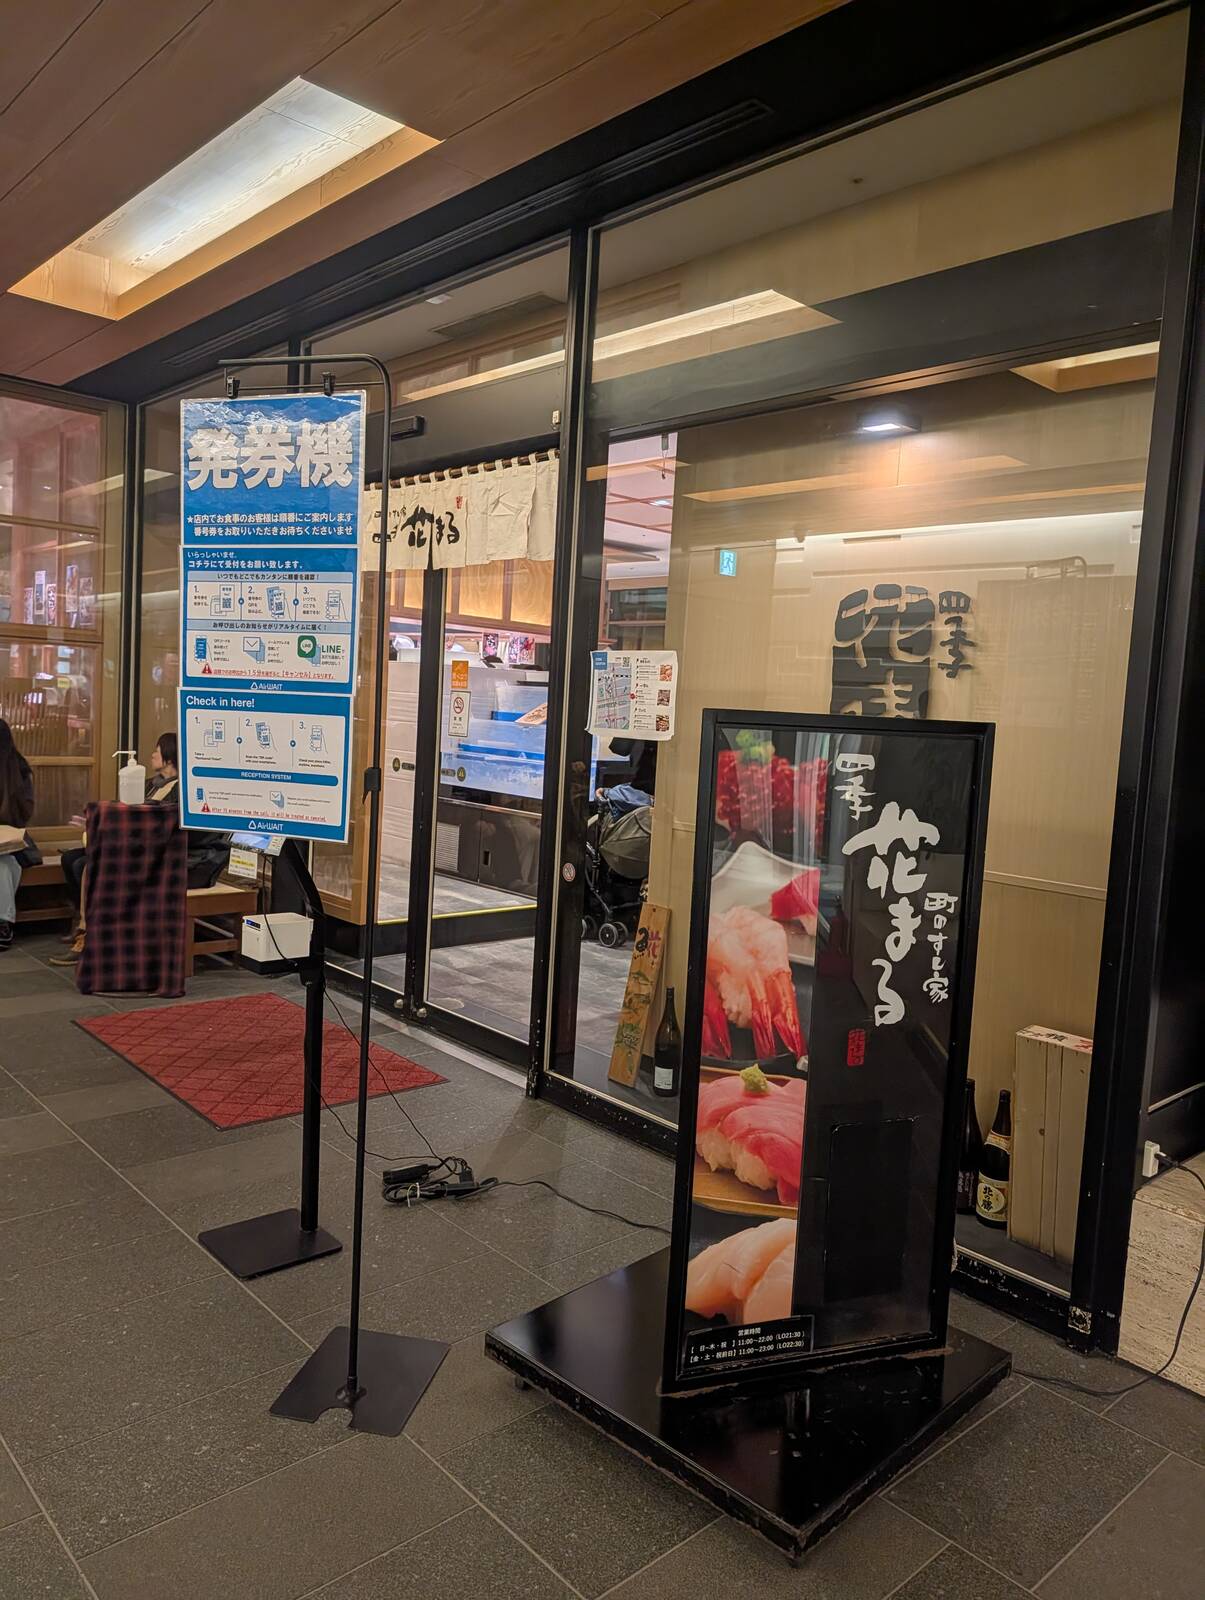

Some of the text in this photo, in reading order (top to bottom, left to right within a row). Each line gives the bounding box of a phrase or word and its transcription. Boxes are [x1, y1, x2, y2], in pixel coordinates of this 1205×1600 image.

[187, 421, 353, 491] 発券機
[194, 525, 352, 537] 番号券をお取りいただきお待ちくださいませ
[188, 560, 302, 569] コチラにて受付をお願い致します。
[186, 695, 255, 708] Check in here!
[834, 752, 877, 821] 四季
[841, 801, 941, 1028] 花まる
